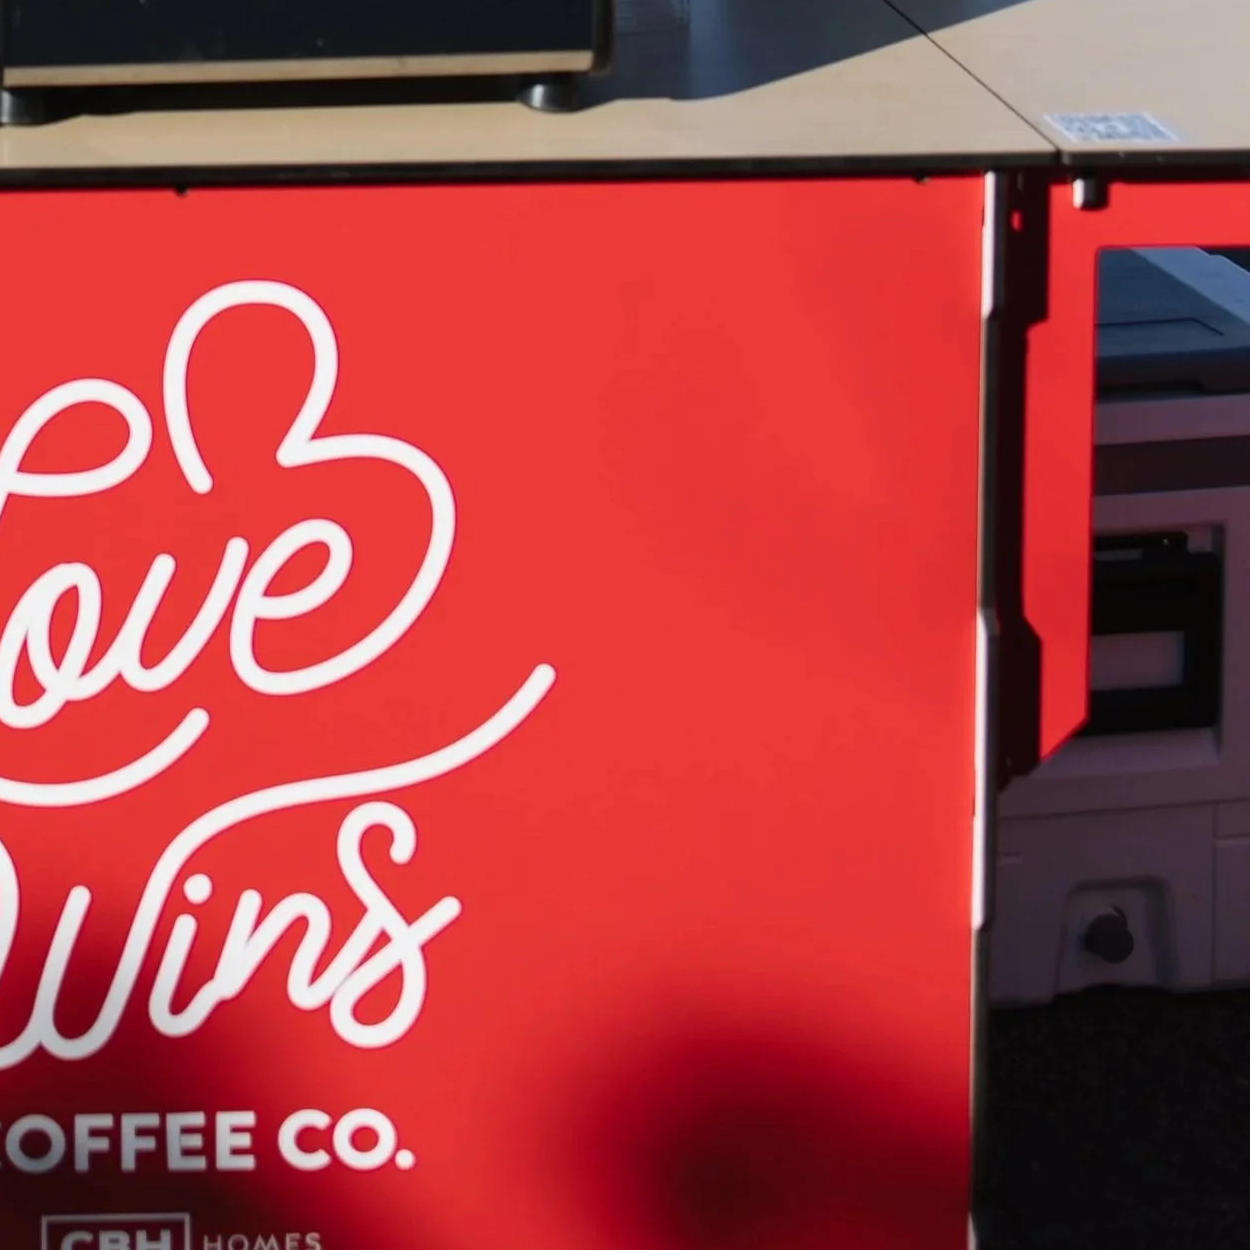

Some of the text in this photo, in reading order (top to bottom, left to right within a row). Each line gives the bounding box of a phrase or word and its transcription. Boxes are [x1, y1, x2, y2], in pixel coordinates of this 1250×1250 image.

[277, 1107, 416, 1171] CO.
[60, 1228, 322, 1250] CBH HOMES
